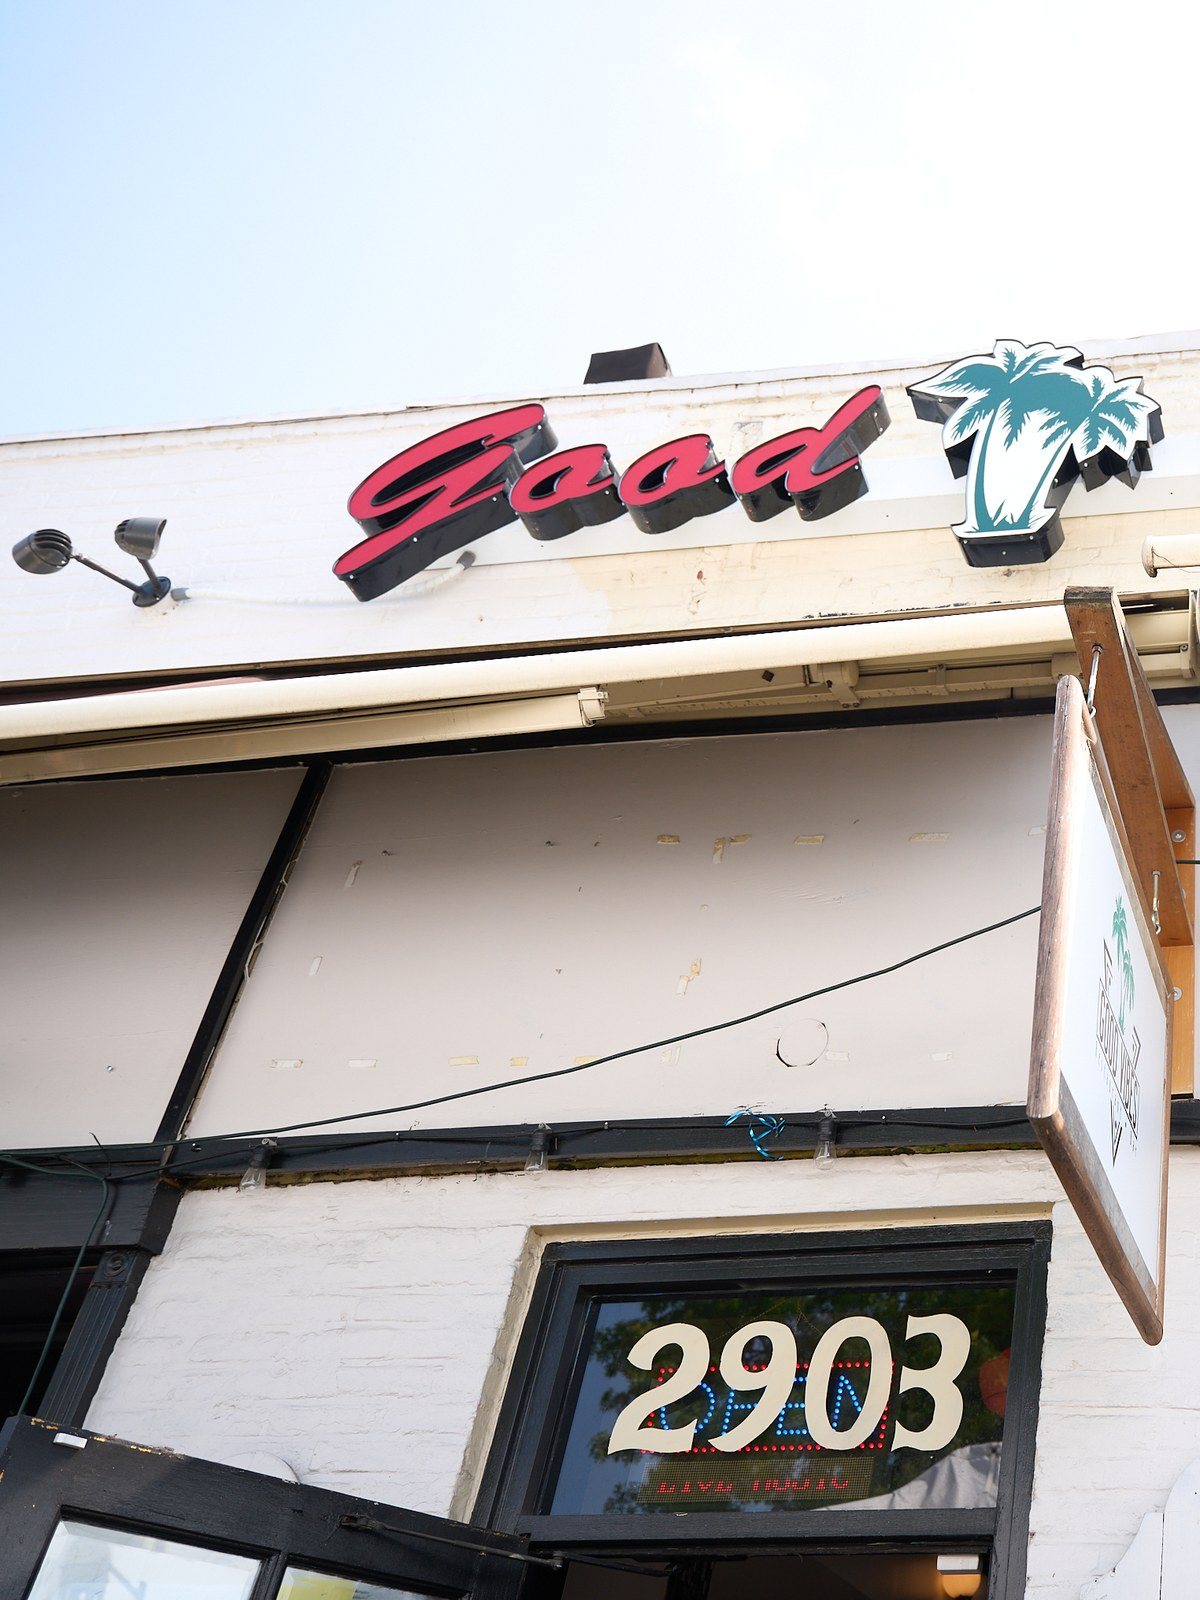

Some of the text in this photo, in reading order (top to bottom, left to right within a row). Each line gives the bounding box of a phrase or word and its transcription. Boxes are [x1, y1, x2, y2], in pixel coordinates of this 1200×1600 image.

[332, 384, 888, 588] Good
[1098, 989, 1119, 1078] GOOD
[607, 1312, 972, 1456] 2903
